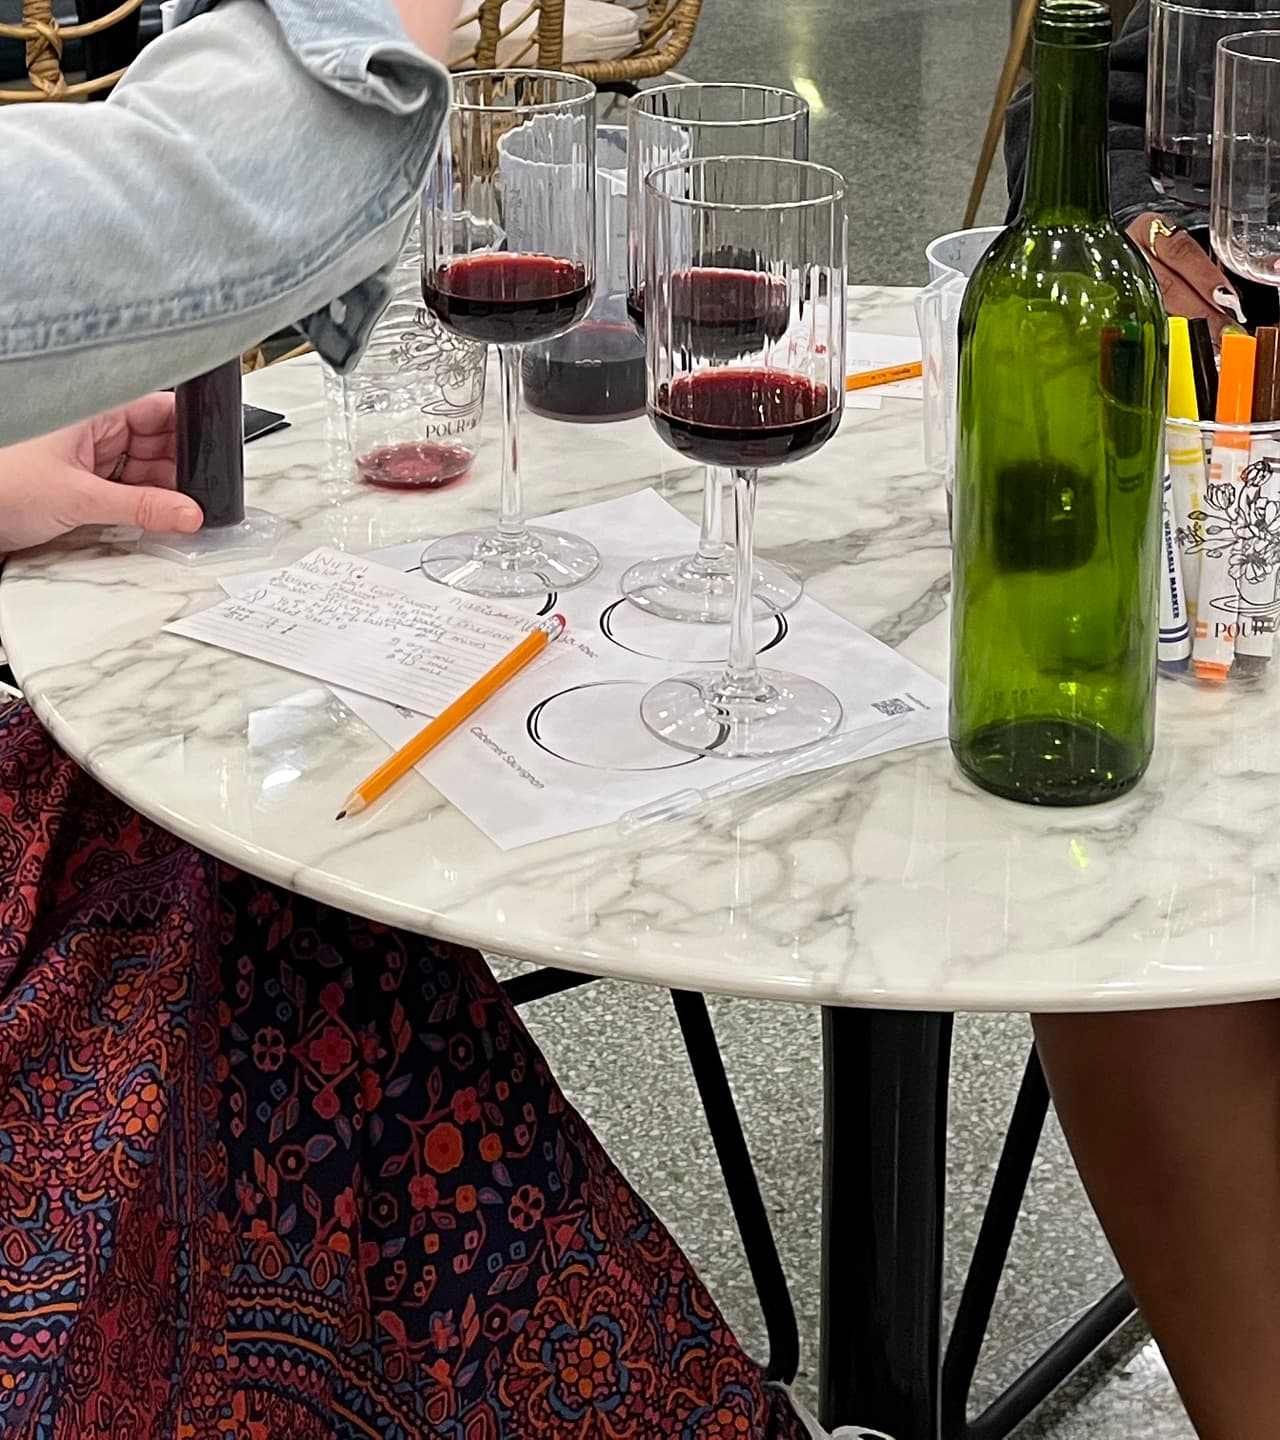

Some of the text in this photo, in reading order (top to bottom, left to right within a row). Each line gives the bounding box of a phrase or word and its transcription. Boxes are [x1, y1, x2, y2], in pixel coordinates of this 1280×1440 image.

[425, 419, 465, 439] POUR
[1164, 520, 1180, 619] WASHABLE MARKER
[1214, 620, 1264, 639] POUR
